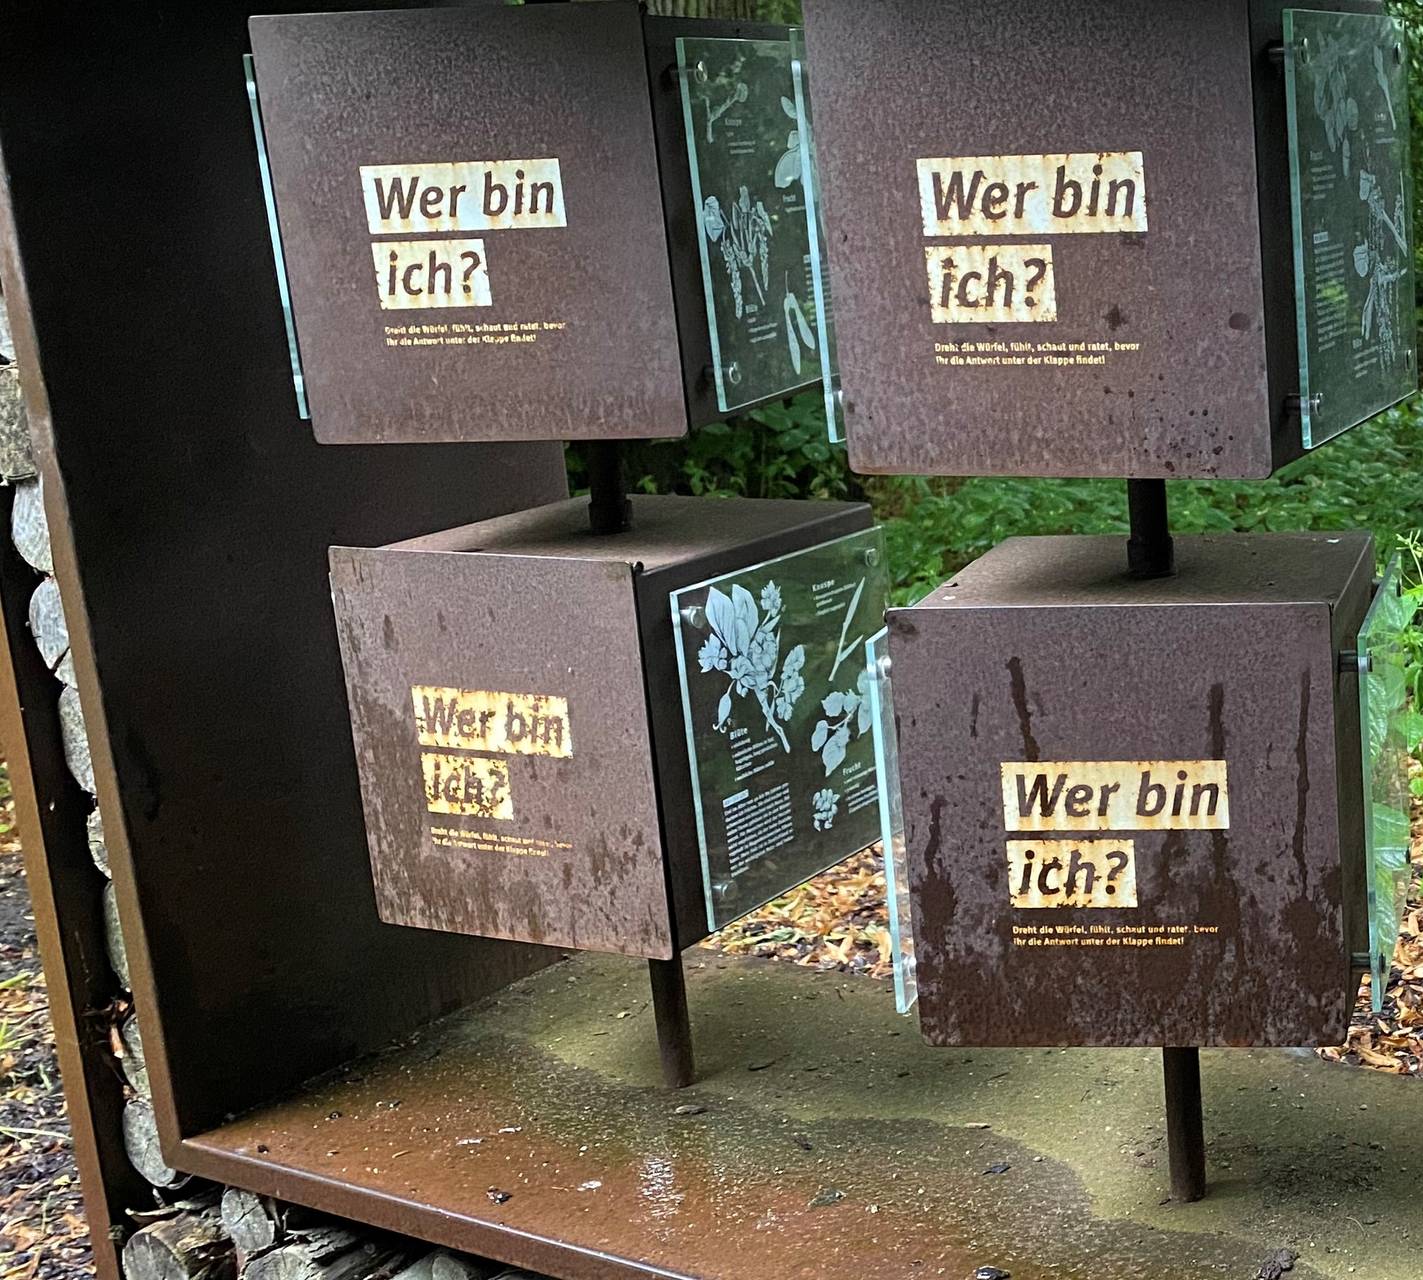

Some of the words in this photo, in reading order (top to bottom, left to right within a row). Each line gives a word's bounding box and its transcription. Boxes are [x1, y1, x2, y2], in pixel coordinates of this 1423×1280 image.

[374, 176, 466, 220] Wer
[483, 169, 554, 217] bin
[932, 170, 1038, 221] Wer
[1052, 164, 1136, 219] bin
[388, 250, 481, 296] ich?
[940, 256, 1046, 308] ich?
[950, 356, 964, 364] die
[966, 356, 1000, 364] Antwort
[1002, 355, 1024, 365] unter
[1027, 355, 1041, 364] der
[1043, 355, 1074, 366] Klappe
[961, 342, 974, 352] die
[977, 342, 1007, 353] Würfel,
[1010, 342, 1033, 353] fühlt,
[1037, 342, 1065, 351] schaut
[1069, 342, 1084, 350] und
[1088, 342, 1111, 351] ratet,
[1114, 342, 1138, 350] bevor
[423, 695, 496, 737] Wer
[506, 698, 563, 747] bin
[1015, 774, 1120, 817] Wer
[1136, 770, 1219, 816] bin
[1020, 850, 1129, 896] ich?
[1039, 925, 1053, 933] die
[1116, 925, 1145, 933] schaut
[1148, 925, 1164, 933] und
[1043, 937, 1078, 945] Antwort
[1080, 937, 1103, 945] unter
[1122, 937, 1152, 946] Klappe
